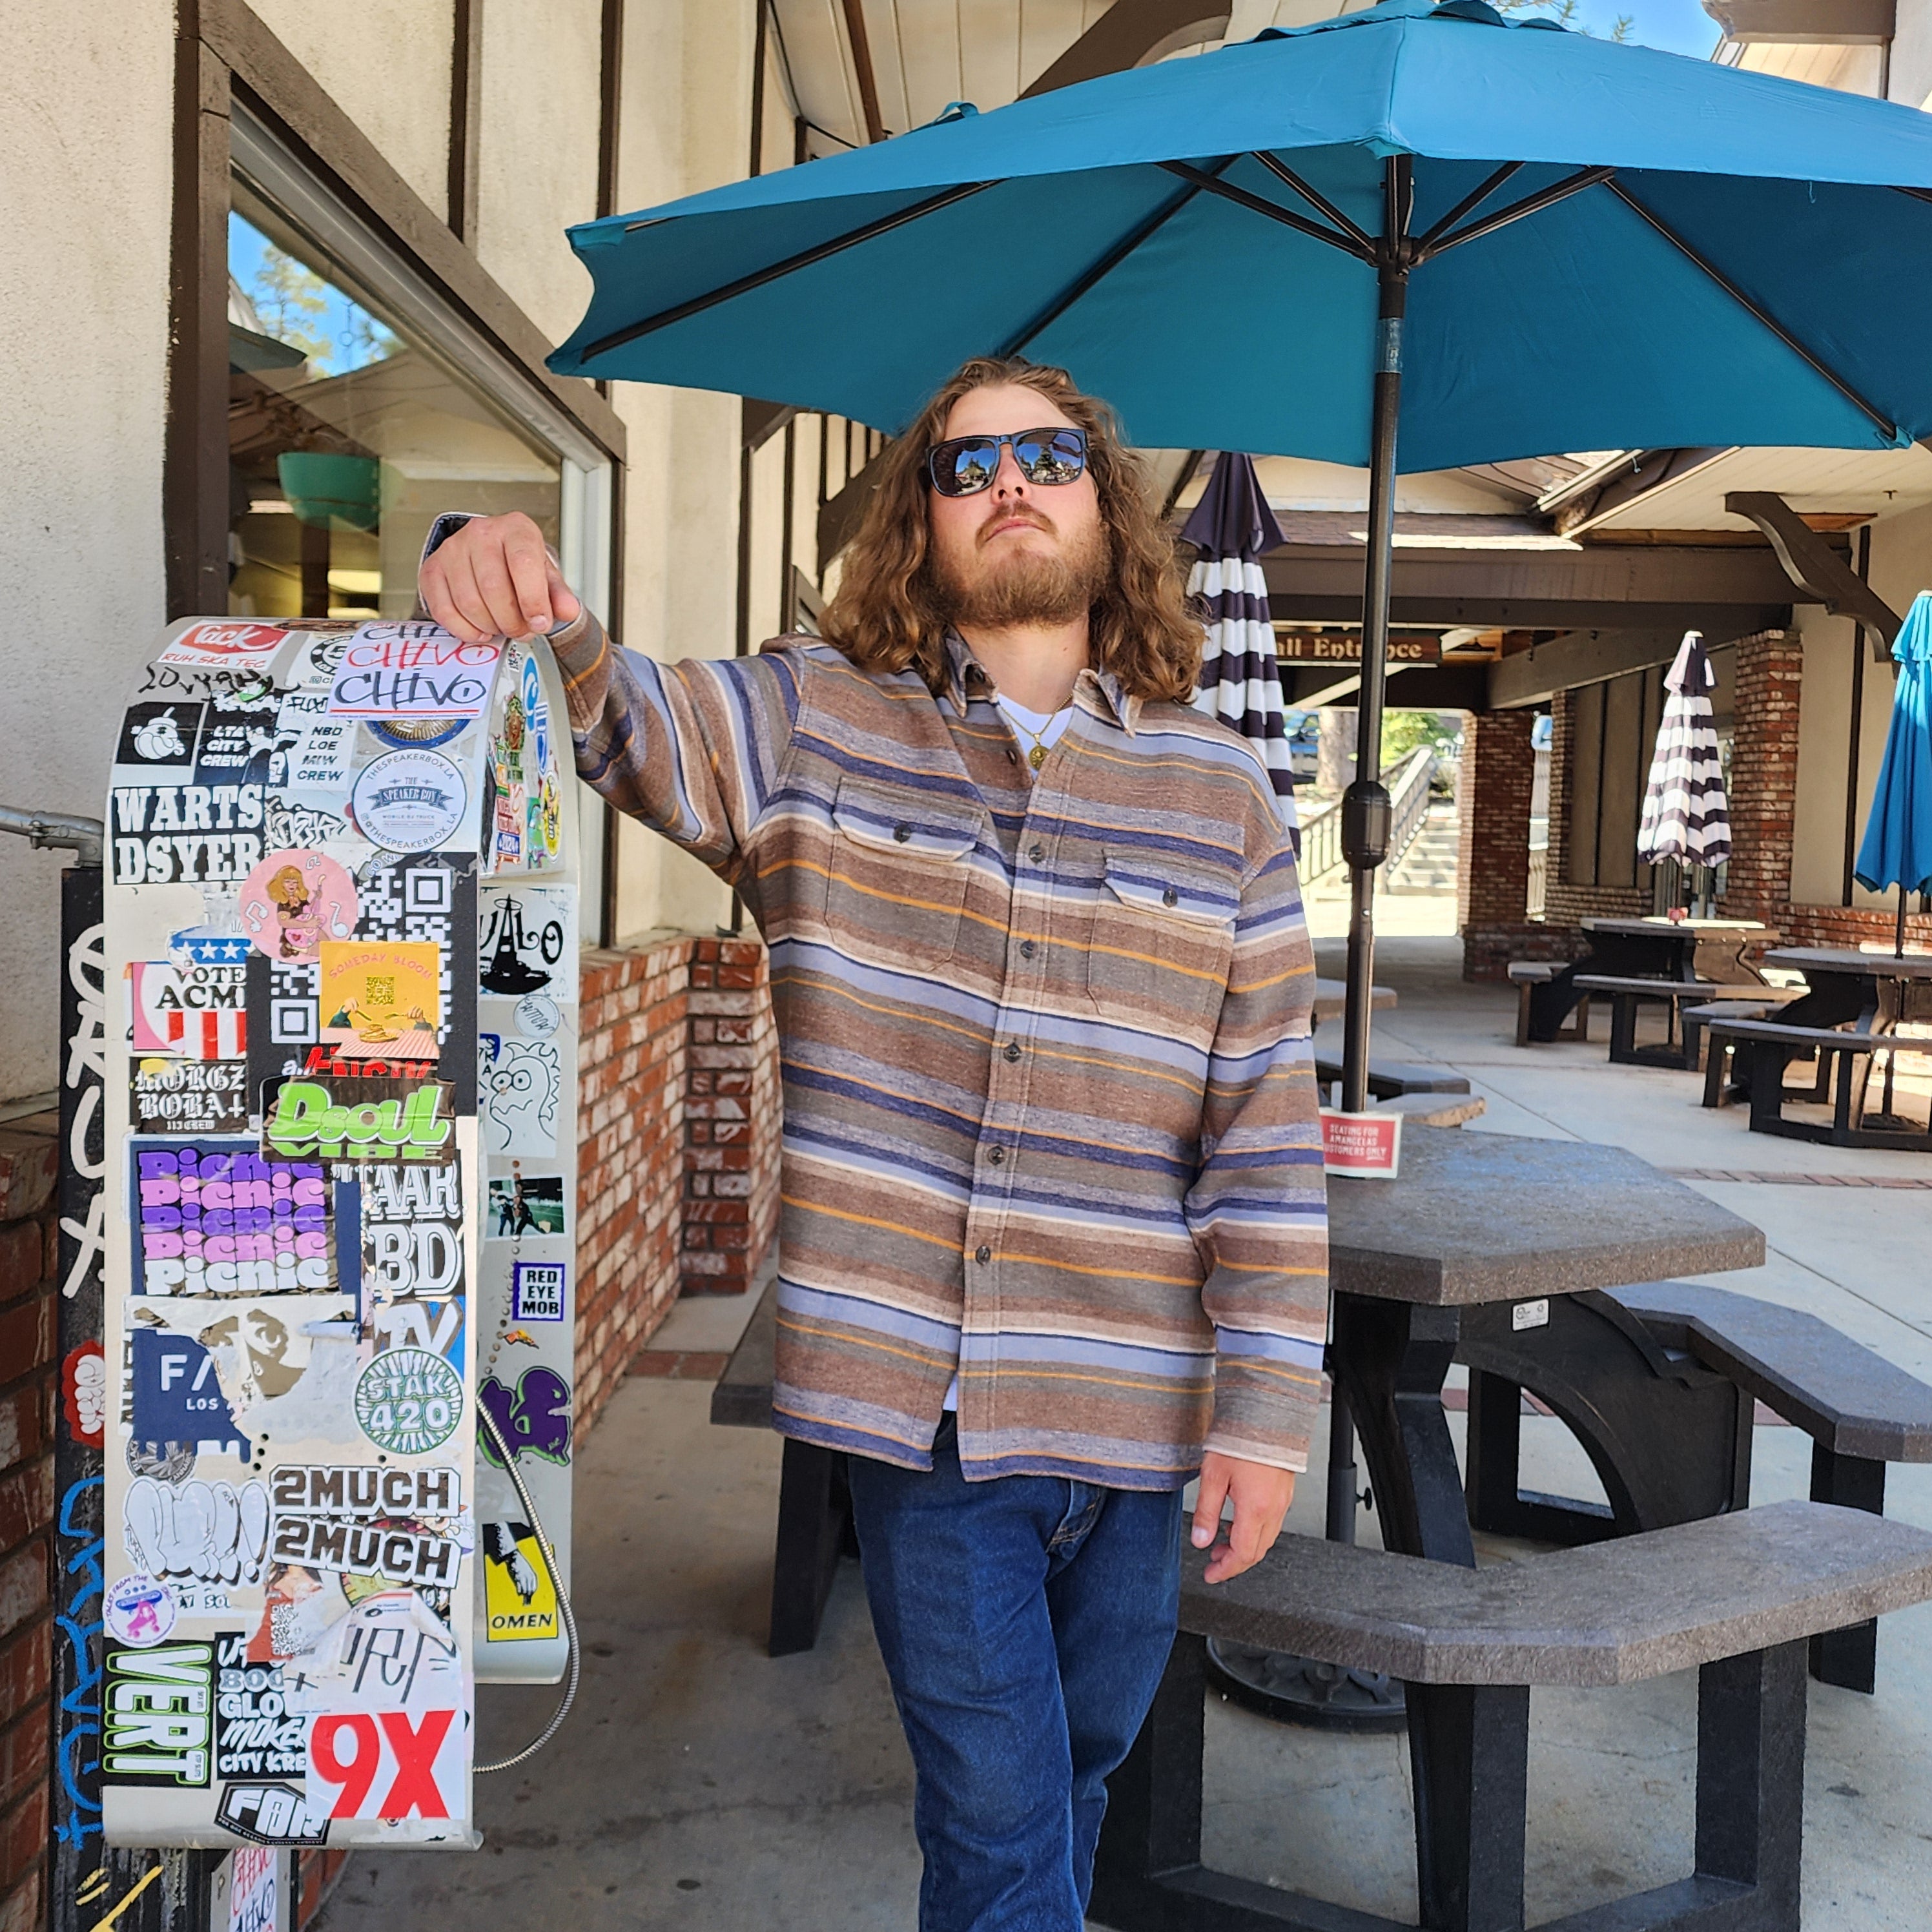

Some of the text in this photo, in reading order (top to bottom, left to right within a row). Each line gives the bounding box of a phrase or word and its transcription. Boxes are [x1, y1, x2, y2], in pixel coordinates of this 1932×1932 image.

[200, 754, 249, 767] CREW
[296, 770, 344, 781] CREW
[114, 783, 262, 832] WARTS
[115, 834, 262, 885] DSYER
[172, 967, 247, 983] VOTE
[329, 952, 433, 981] SOMEDAY BLOOM
[154, 985, 246, 1009] ACM
[1324, 1144, 1365, 1156] USTOMERS
[145, 1251, 329, 1295] Picnic
[526, 1270, 557, 1283] RED
[528, 1286, 555, 1299] EYE
[522, 1301, 559, 1315] MOB
[369, 1398, 451, 1433] 420
[271, 1468, 453, 1510] 2MUCH
[272, 1517, 455, 1581] 2MUCH
[491, 1613, 553, 1630] OMEN
[108, 1646, 211, 1783] VERT
[311, 1709, 456, 1819] 9X
